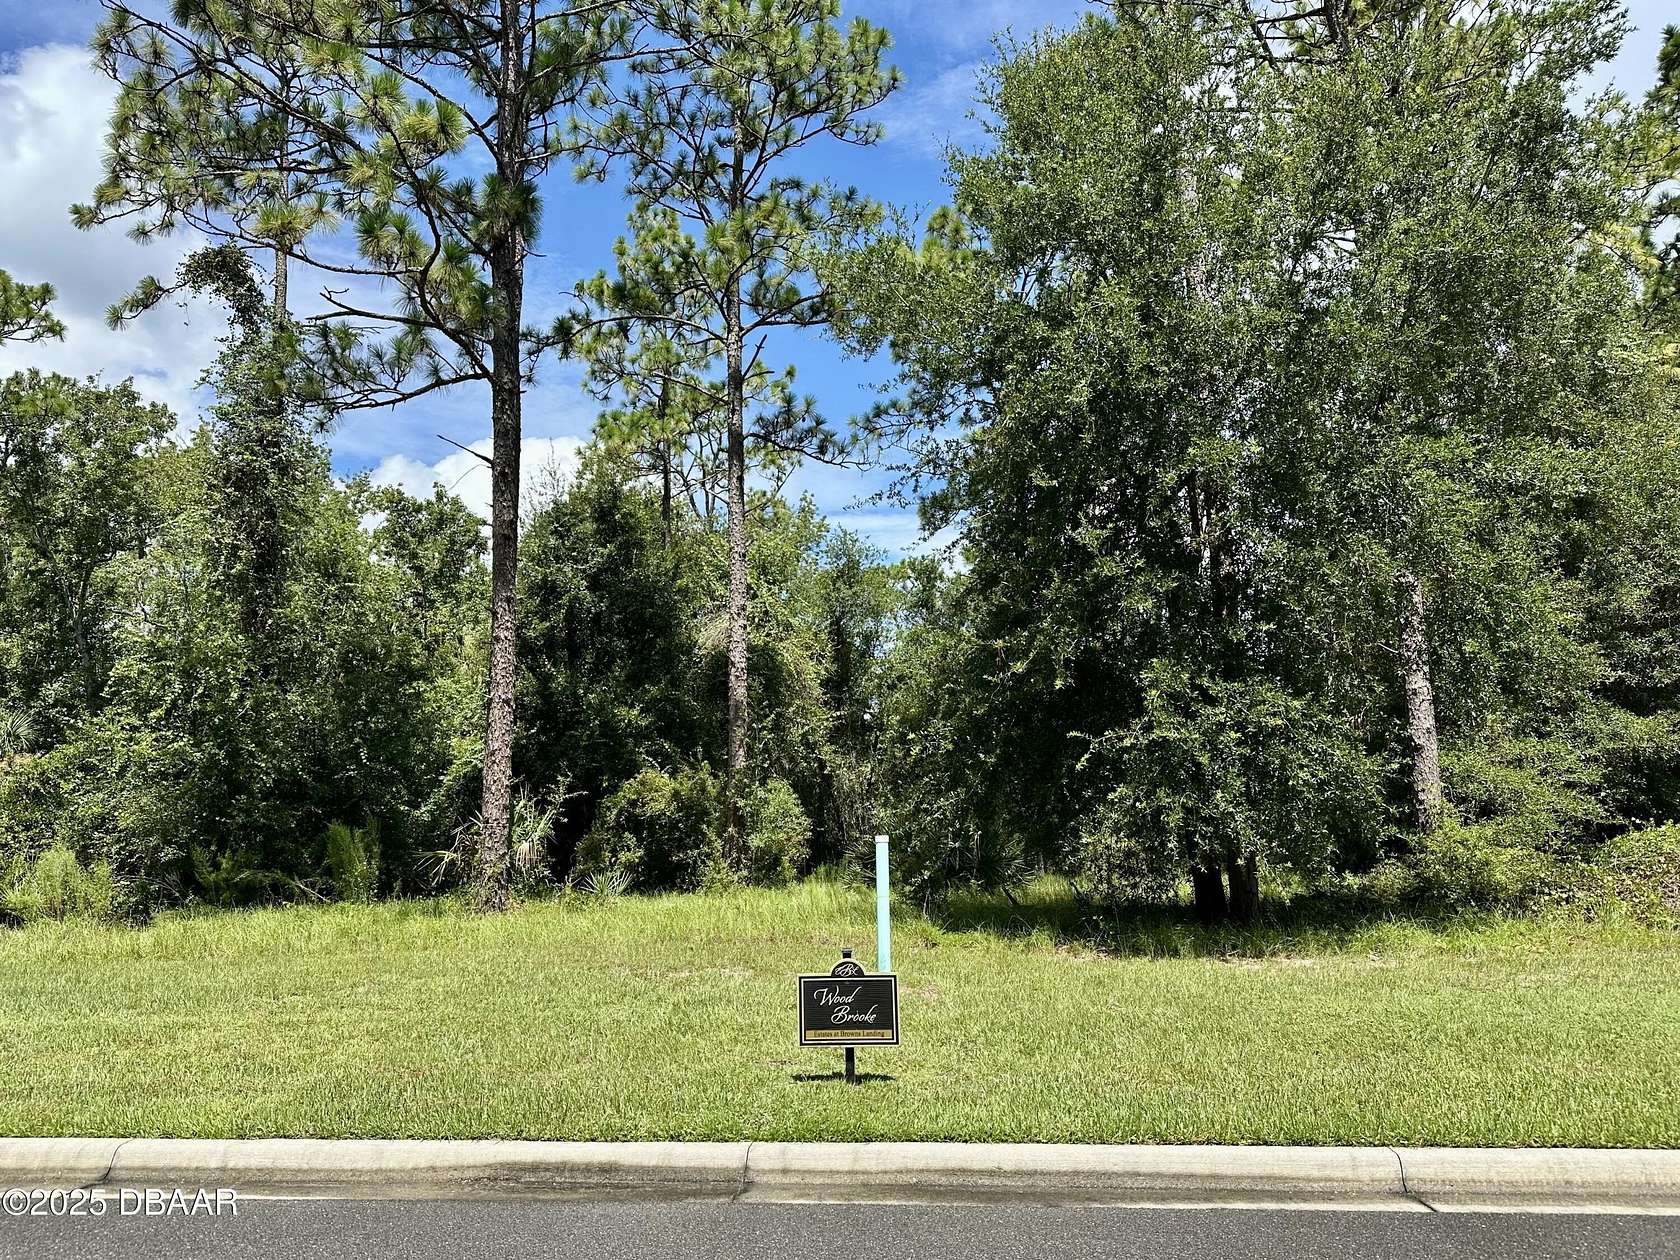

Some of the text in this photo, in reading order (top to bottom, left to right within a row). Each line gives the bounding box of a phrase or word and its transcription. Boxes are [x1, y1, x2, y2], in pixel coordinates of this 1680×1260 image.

[813, 985, 862, 1006] Wood
[830, 1004, 879, 1025] Brooke
[813, 1030, 833, 1038] Estates
[862, 1030, 885, 1038] Landing
